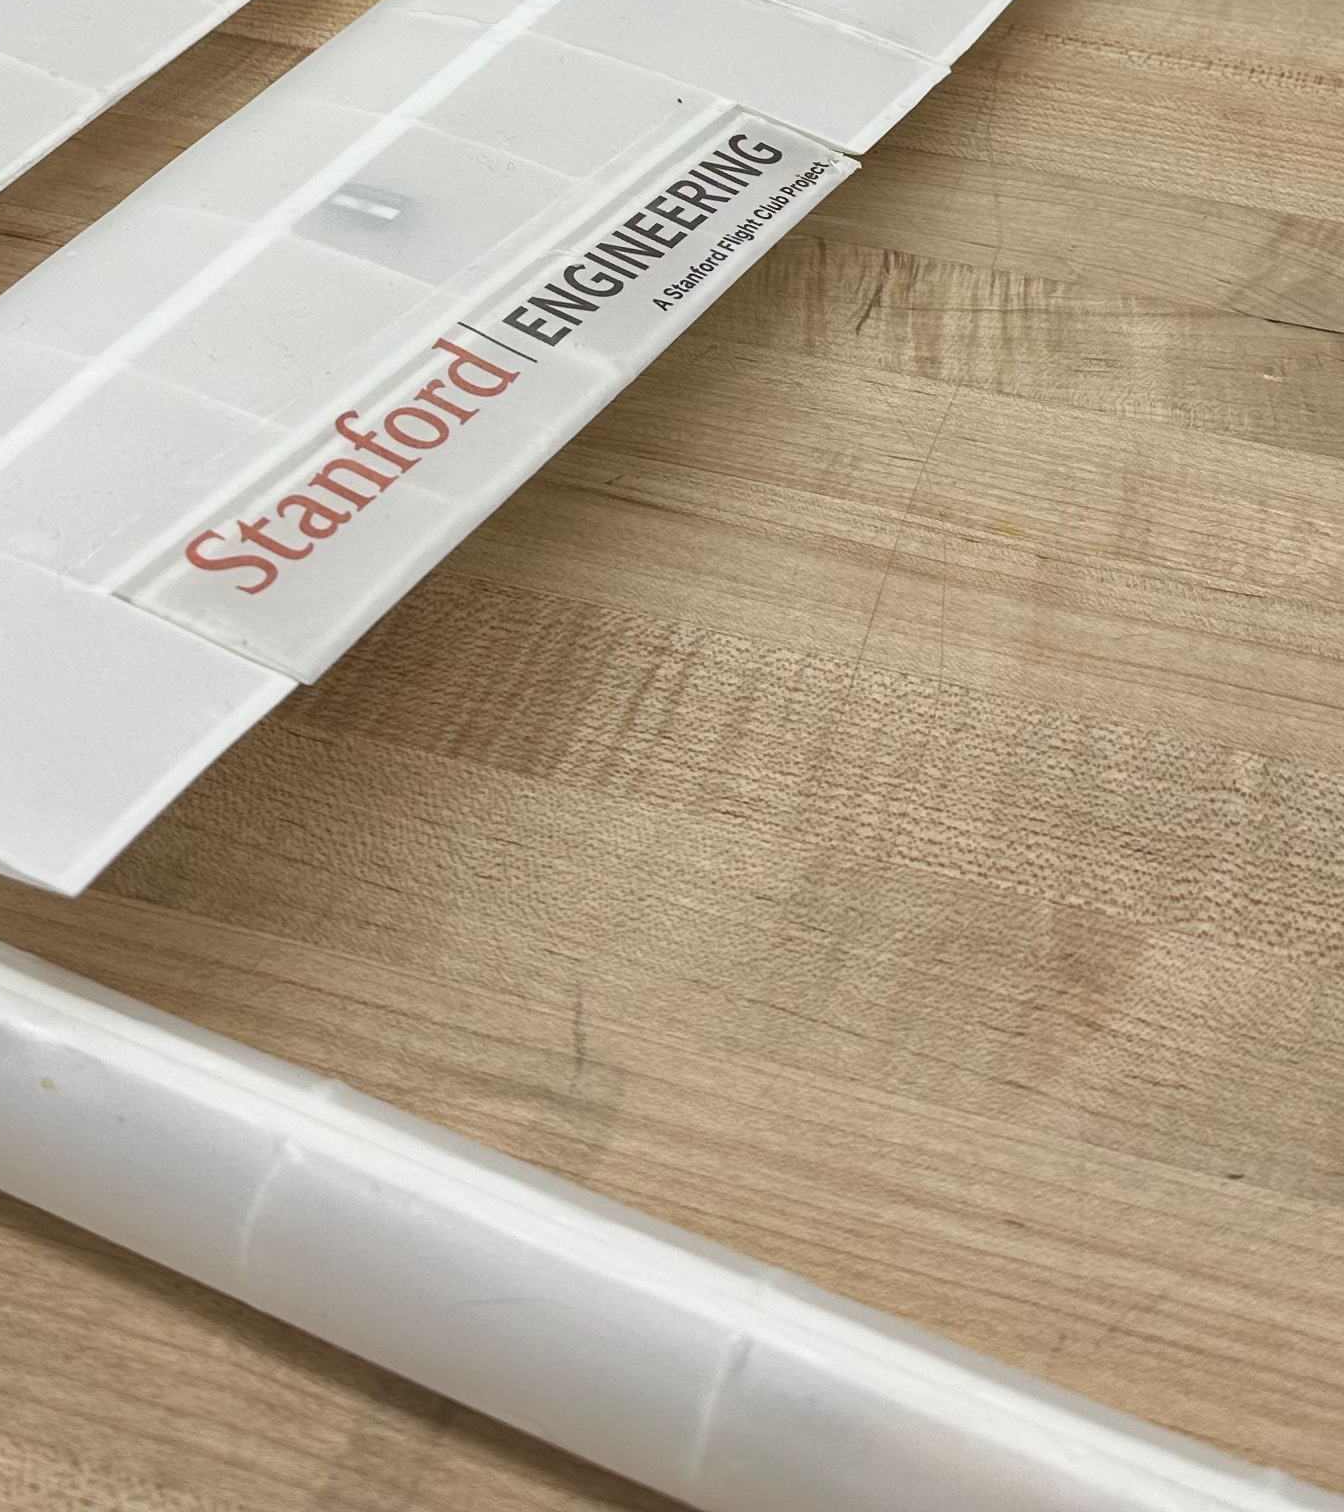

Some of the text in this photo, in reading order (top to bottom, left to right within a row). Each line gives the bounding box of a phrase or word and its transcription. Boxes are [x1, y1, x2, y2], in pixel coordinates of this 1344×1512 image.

[184, 133, 784, 595] Stanford ENGINEERING
[652, 160, 831, 312] A Stanford Flight Club Project
